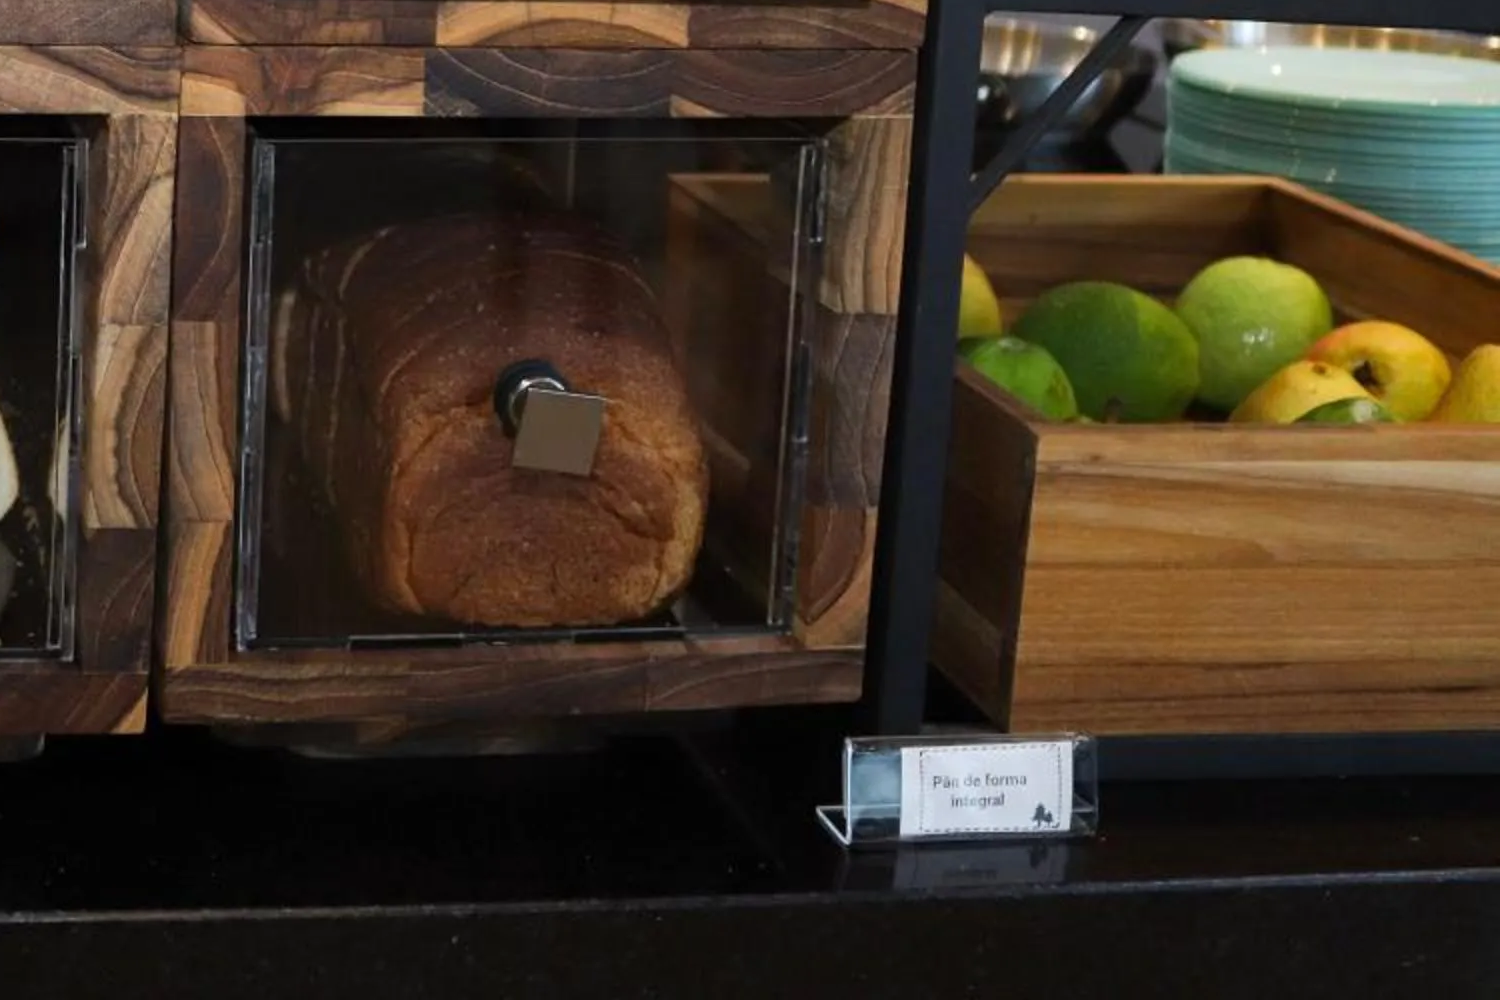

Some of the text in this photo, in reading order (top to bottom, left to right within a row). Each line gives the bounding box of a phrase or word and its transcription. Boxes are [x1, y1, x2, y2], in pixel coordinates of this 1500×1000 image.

[964, 772, 981, 788] de
[984, 771, 1028, 787] forma
[950, 793, 1006, 809] integral
